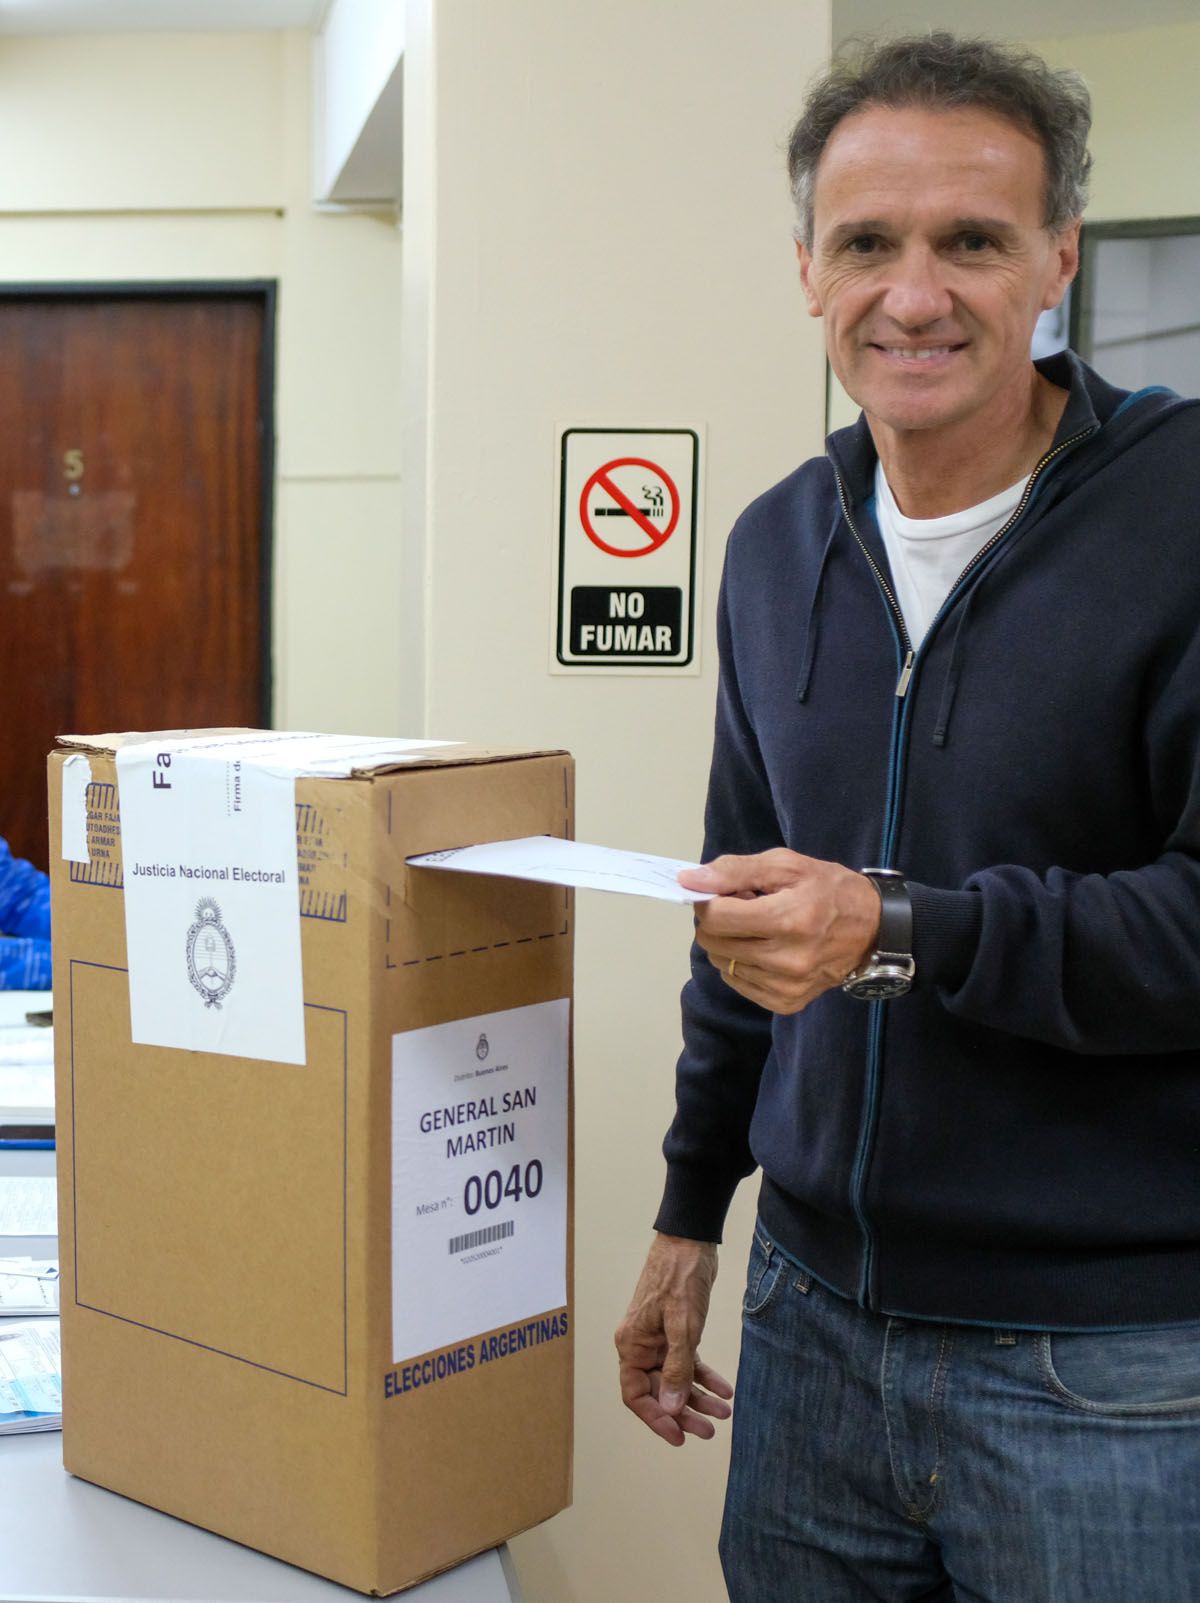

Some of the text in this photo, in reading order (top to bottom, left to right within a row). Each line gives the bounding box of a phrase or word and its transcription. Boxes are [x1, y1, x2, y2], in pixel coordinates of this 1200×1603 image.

[609, 592, 645, 619] NO
[580, 624, 672, 651] FUMAR
[92, 848, 110, 857] URNA
[133, 863, 285, 883] Justicia Nacional Electoral
[420, 1086, 536, 1133] GENERAL SAN
[447, 1122, 515, 1159] MARTIN
[416, 1202, 439, 1216] Mesa
[464, 1159, 543, 1215] 0040
[384, 1313, 568, 1399] ELECCIONES ARGENTINAS
